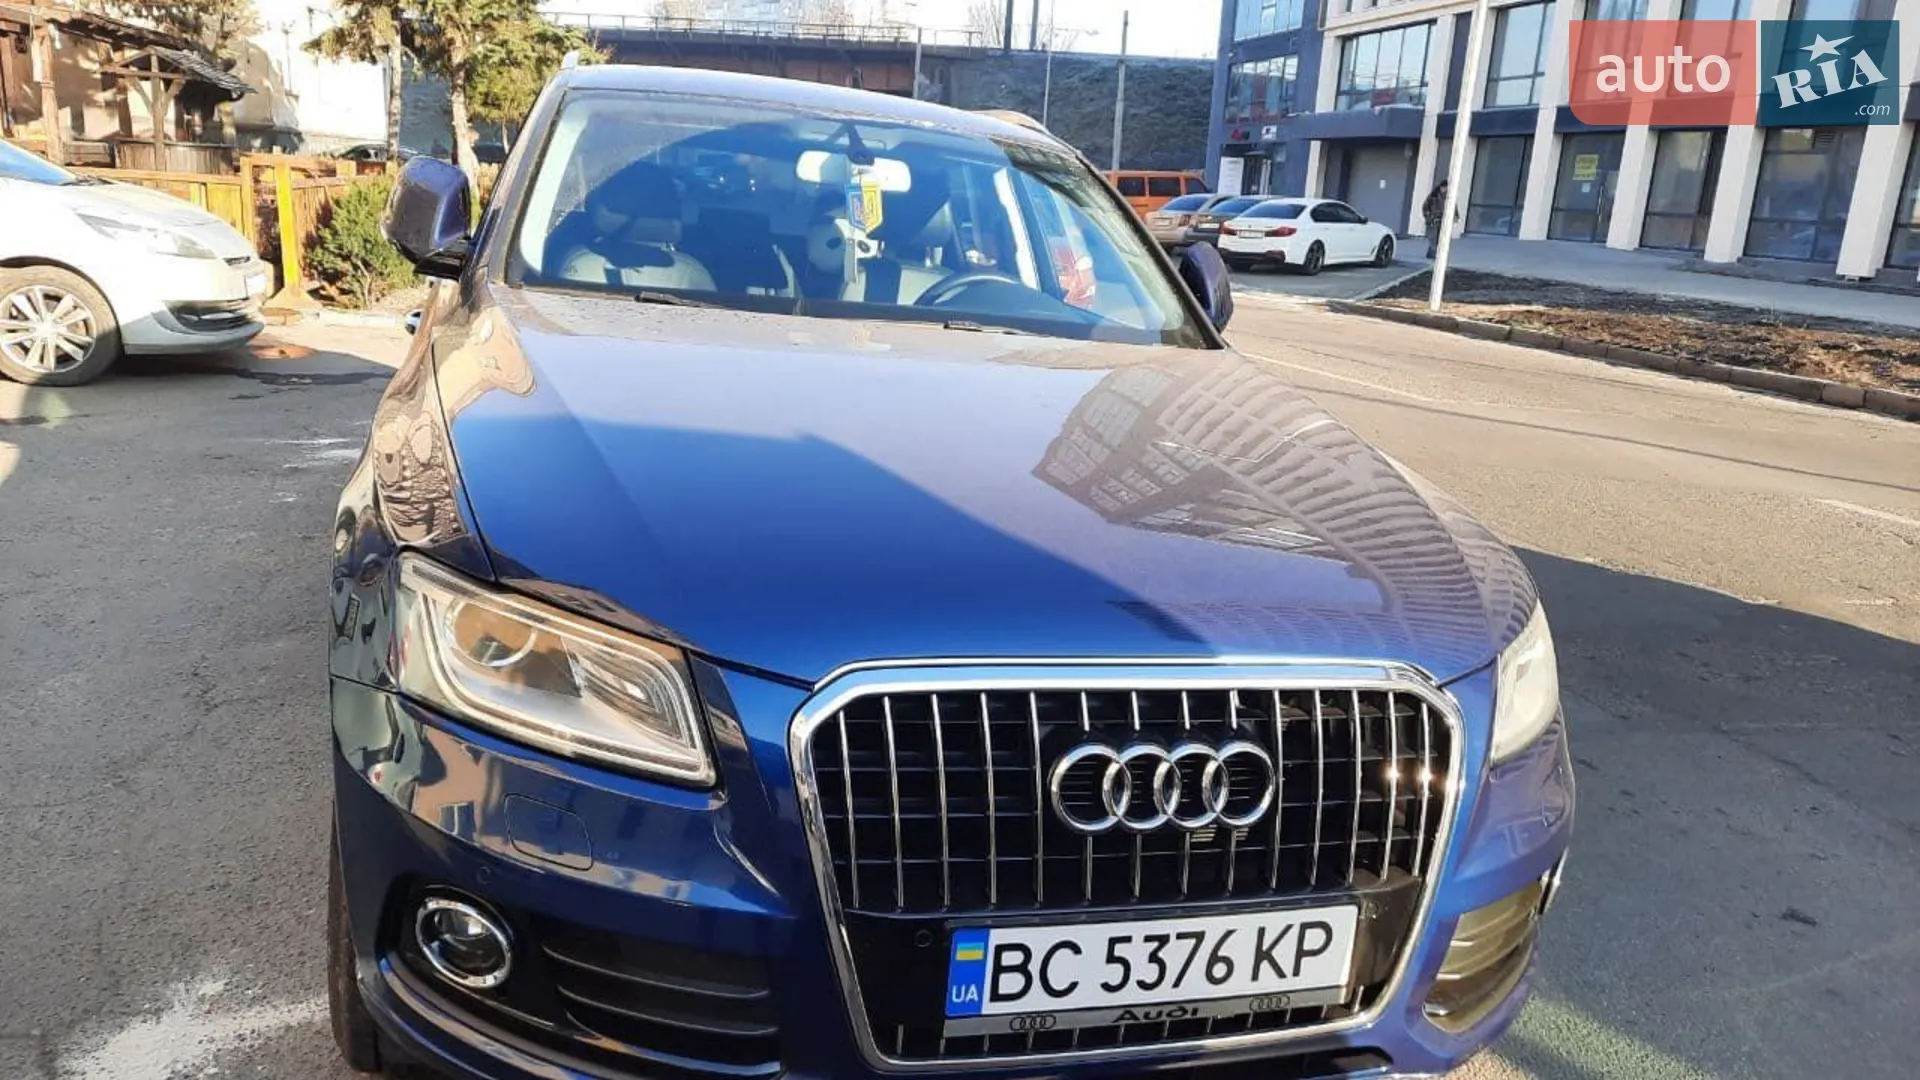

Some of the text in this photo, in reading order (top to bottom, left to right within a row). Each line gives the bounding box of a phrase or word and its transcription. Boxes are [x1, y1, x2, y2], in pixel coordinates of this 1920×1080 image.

[989, 920, 1333, 1003] BC 5376 KP
[952, 984, 979, 1003] UA
[1112, 1006, 1200, 1024] Audi
